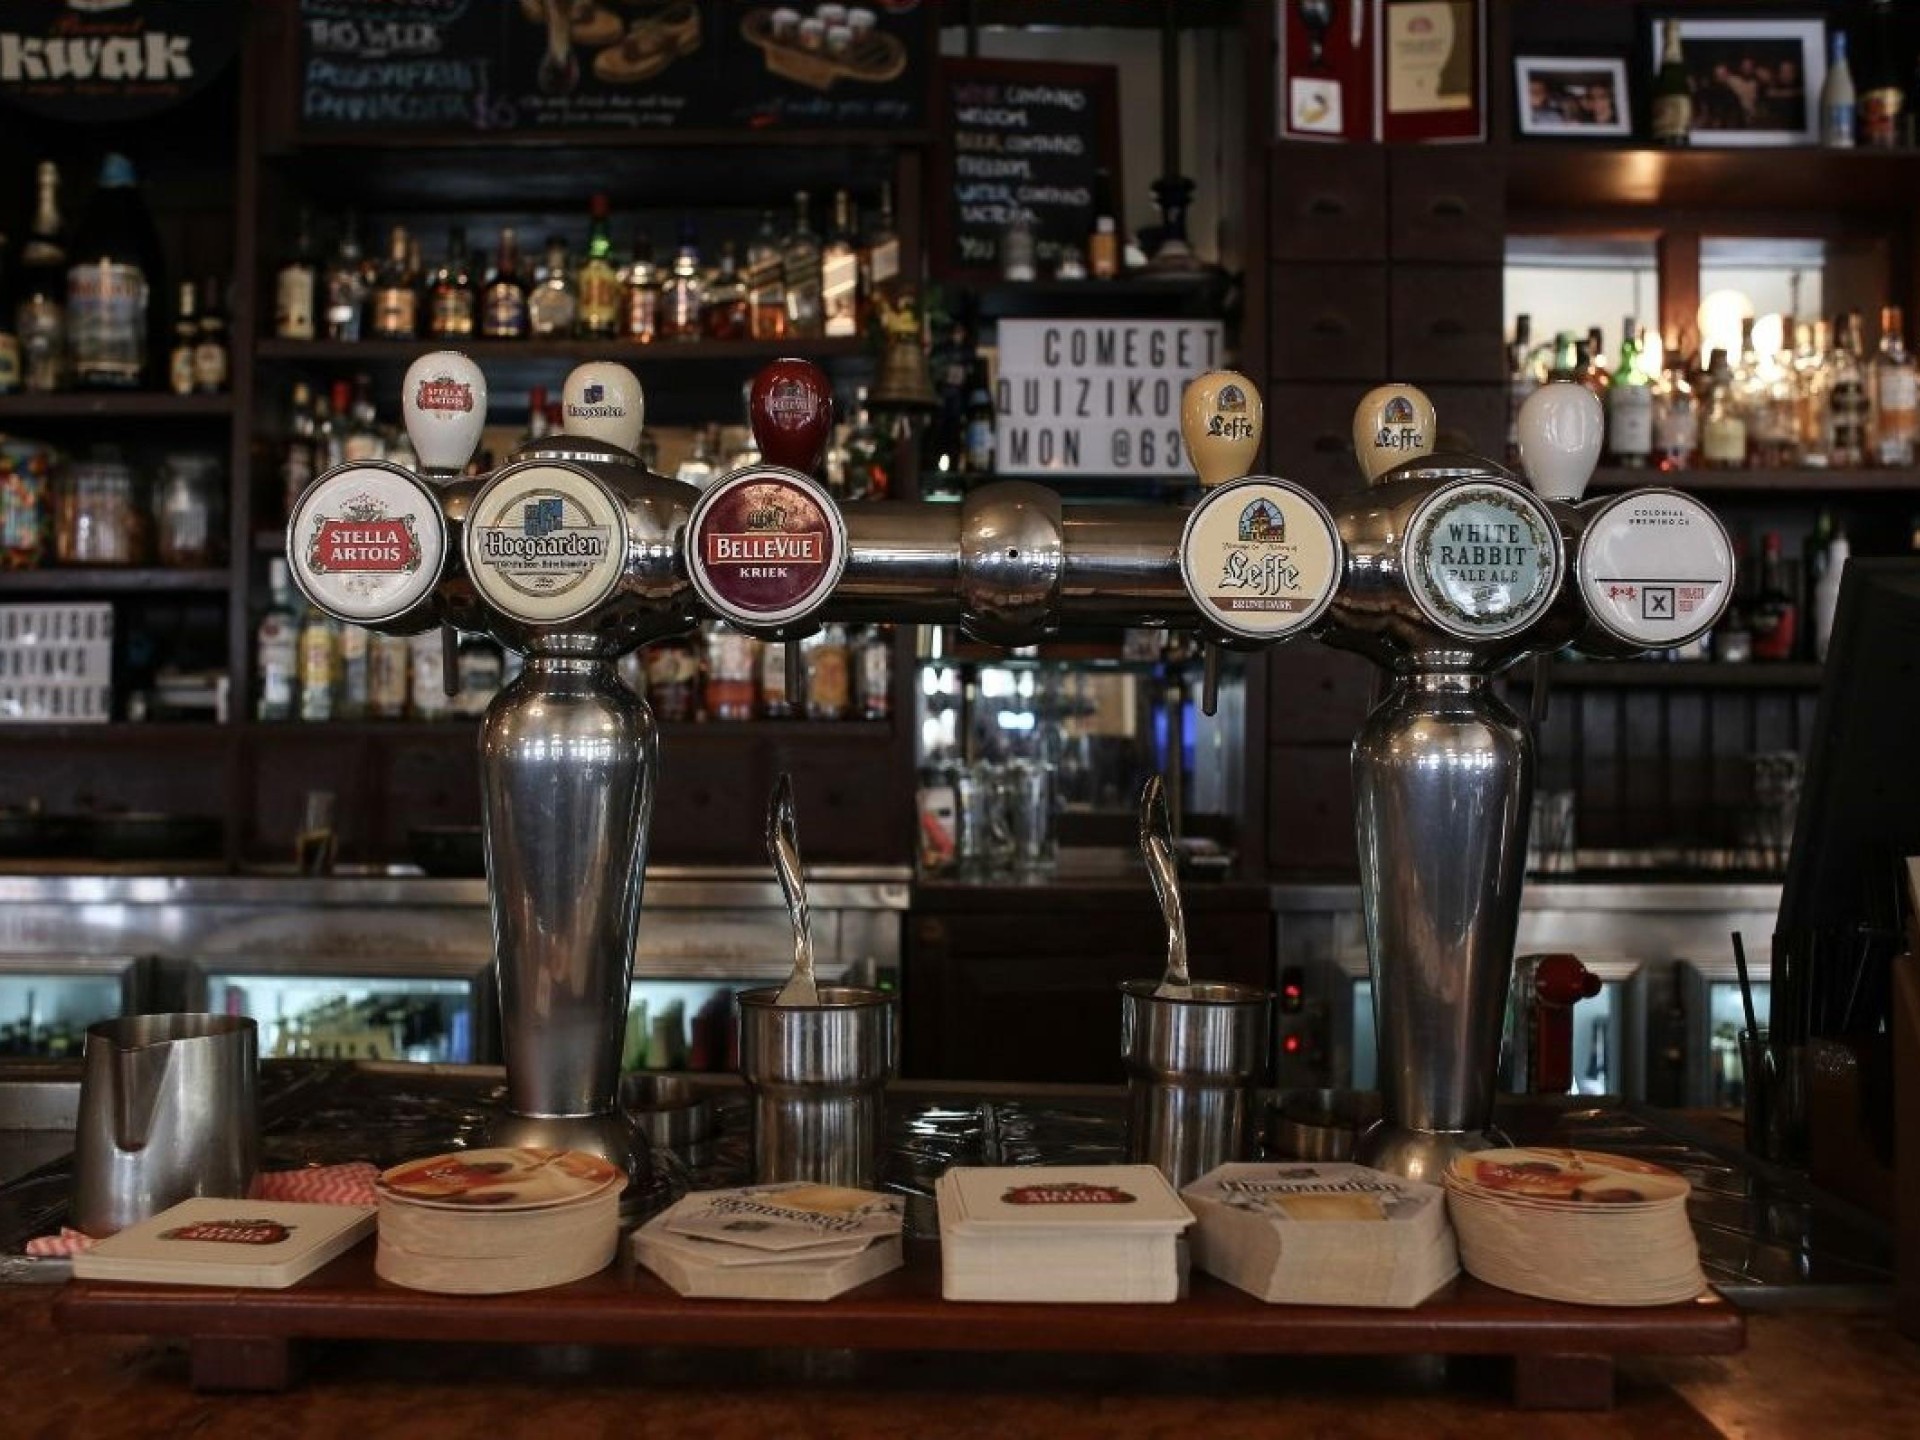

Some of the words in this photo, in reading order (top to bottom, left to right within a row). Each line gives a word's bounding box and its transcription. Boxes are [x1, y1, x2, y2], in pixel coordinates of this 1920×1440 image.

[1206, 414, 1254, 441] Leffe
[1010, 429, 1080, 468] MON
[1374, 426, 1424, 452] Leffe
[1628, 518, 1676, 526] BREWING
[330, 530, 399, 544] STELLA
[1449, 523, 1520, 543] WHITE
[330, 547, 400, 561] ARTOIS
[485, 531, 601, 560] Hoegaarden
[1440, 545, 1527, 565] RABBIT
[739, 567, 788, 578] KRIEK
[1218, 550, 1301, 596] Leffe
[1449, 569, 1486, 582] PALE
[1489, 569, 1518, 583] ALE
[1651, 594, 1666, 612] X
